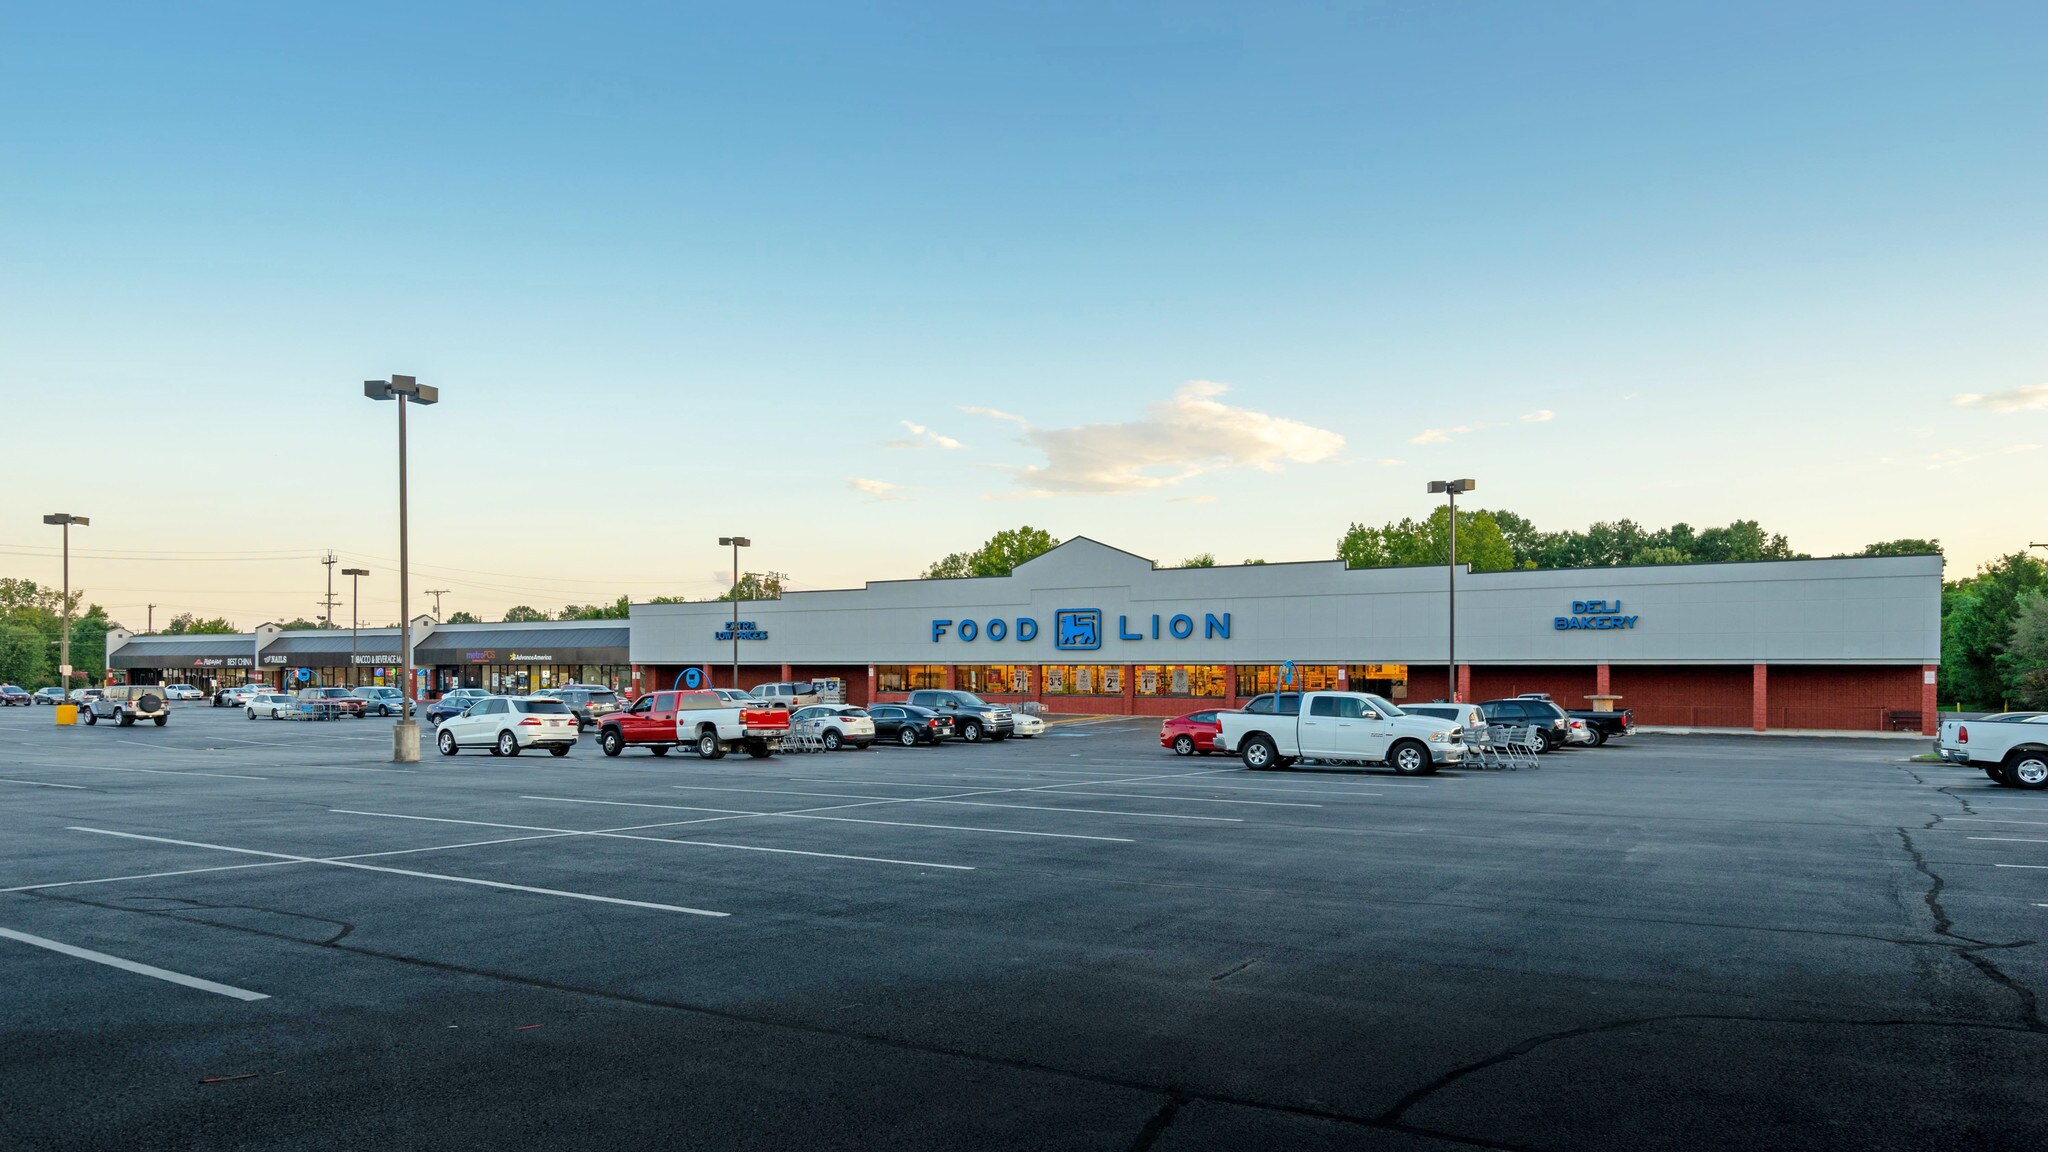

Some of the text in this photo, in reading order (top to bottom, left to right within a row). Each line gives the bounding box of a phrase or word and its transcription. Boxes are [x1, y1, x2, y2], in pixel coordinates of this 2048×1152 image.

[1573, 600, 1620, 614] DELI
[932, 612, 1230, 642] FOOD LION
[1554, 615, 1638, 630] BAKERY
[715, 631, 768, 640] LOW PRICES
[351, 655, 370, 663] TBACCO
